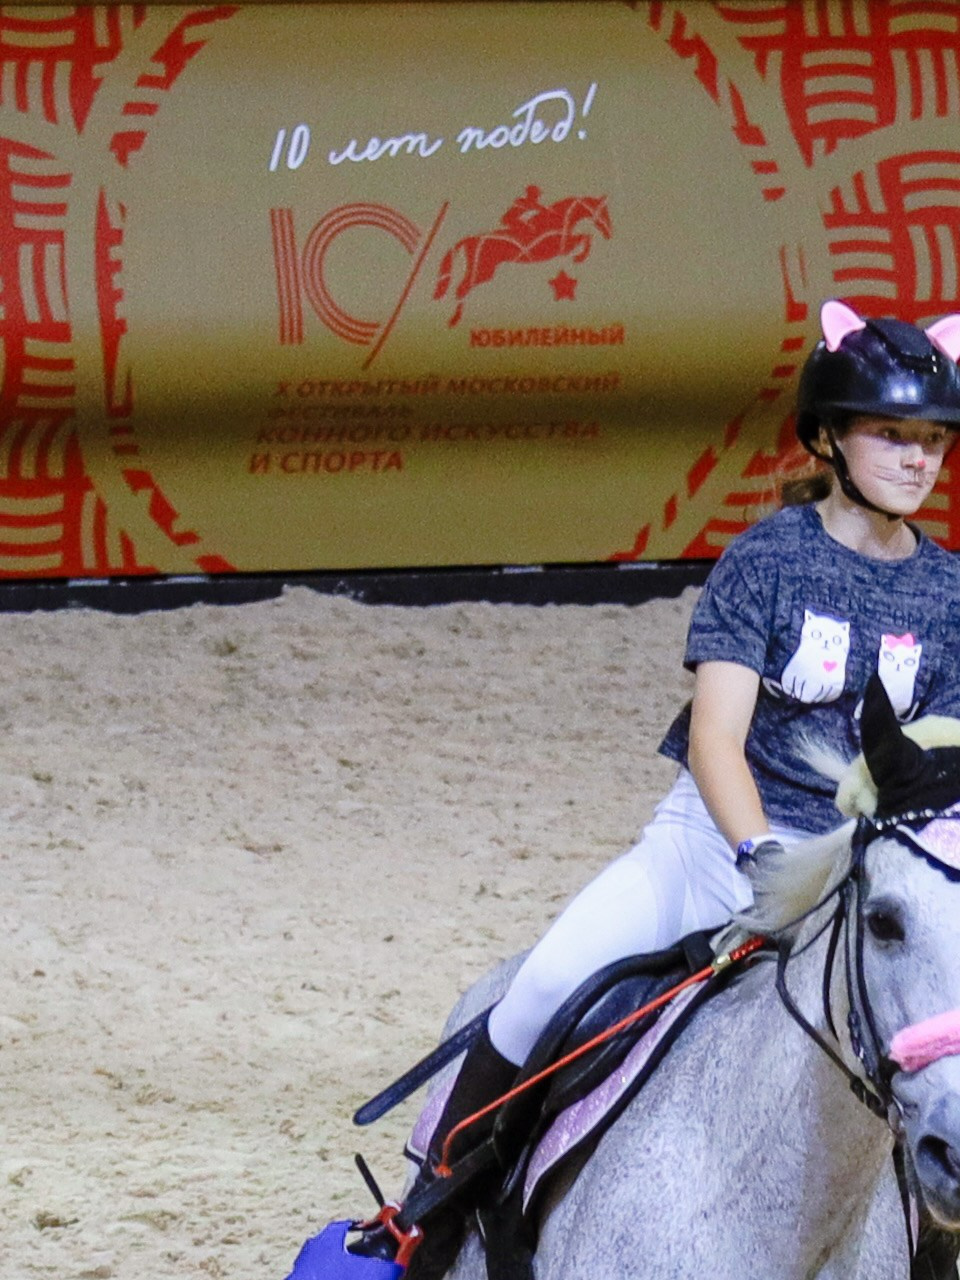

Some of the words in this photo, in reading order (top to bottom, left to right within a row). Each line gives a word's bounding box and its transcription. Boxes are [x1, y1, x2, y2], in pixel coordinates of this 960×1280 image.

[269, 124, 311, 172] 10
[328, 131, 444, 166] лет
[457, 82, 598, 154] побед!
[471, 324, 625, 347] ЮБИЛЕЙНЫЙ
[296, 375, 440, 397] ОТКРЫТЫЙ
[446, 371, 620, 394] МОСКОВСКИЙ
[257, 424, 411, 445] КОННОГО
[421, 420, 601, 441] ИСКУССТВА
[248, 452, 271, 474] И
[279, 449, 404, 474] СПОРТА
